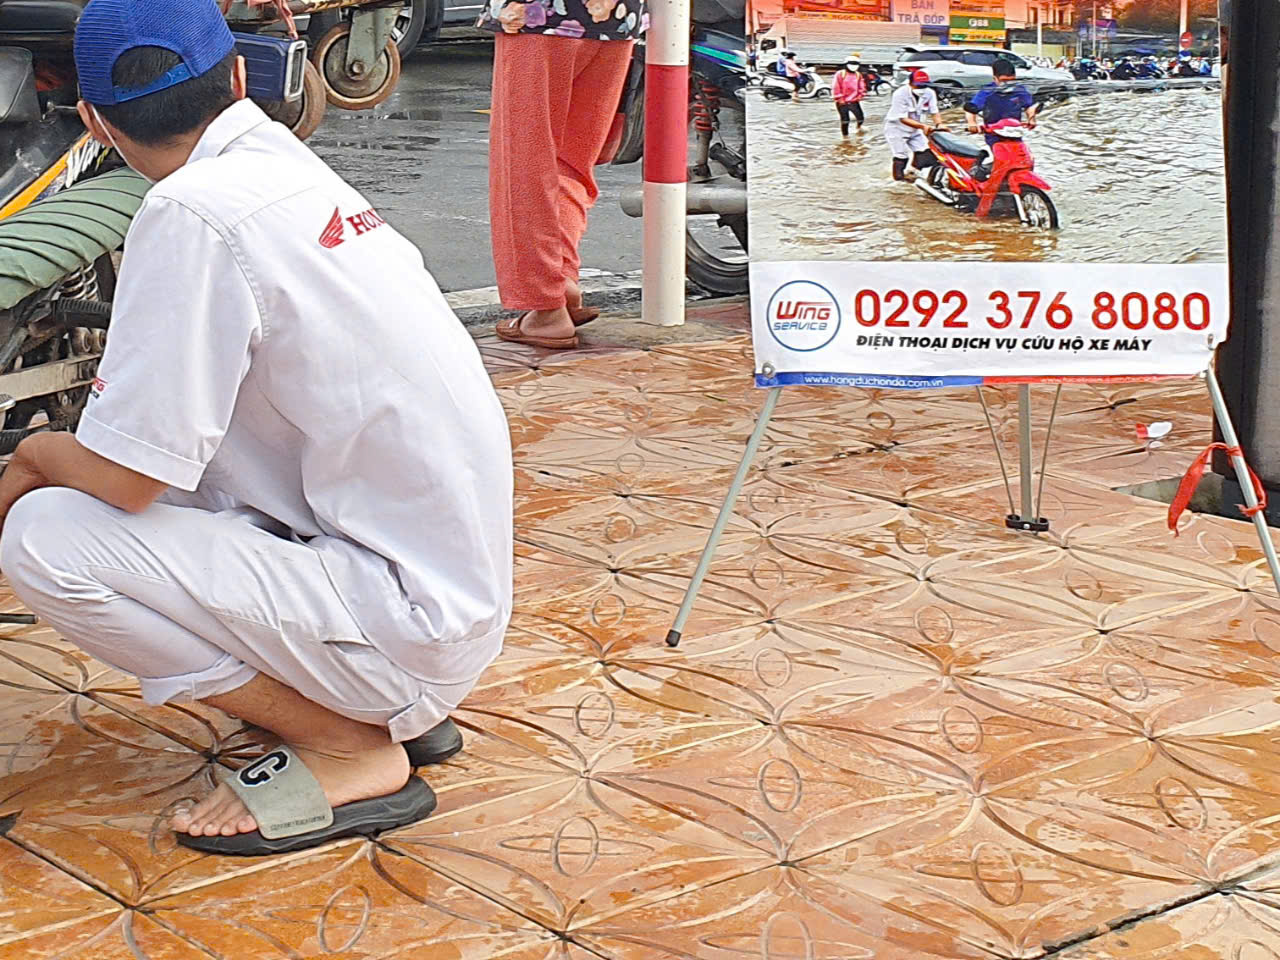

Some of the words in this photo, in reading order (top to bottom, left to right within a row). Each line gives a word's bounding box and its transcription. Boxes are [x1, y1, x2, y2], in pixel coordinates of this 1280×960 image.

[854, 289, 969, 330] 0292
[985, 290, 1074, 330] 376
[1091, 291, 1210, 331] 8080
[856, 334, 893, 349] ĐIỆN
[898, 336, 947, 351] THOẠI
[951, 337, 990, 352] DỊCH
[996, 337, 1018, 353] VỤ
[1021, 335, 1055, 351] CỨU
[1058, 336, 1085, 354] HỘ
[1087, 339, 1113, 351] XE
[1113, 336, 1153, 352] MÁY
